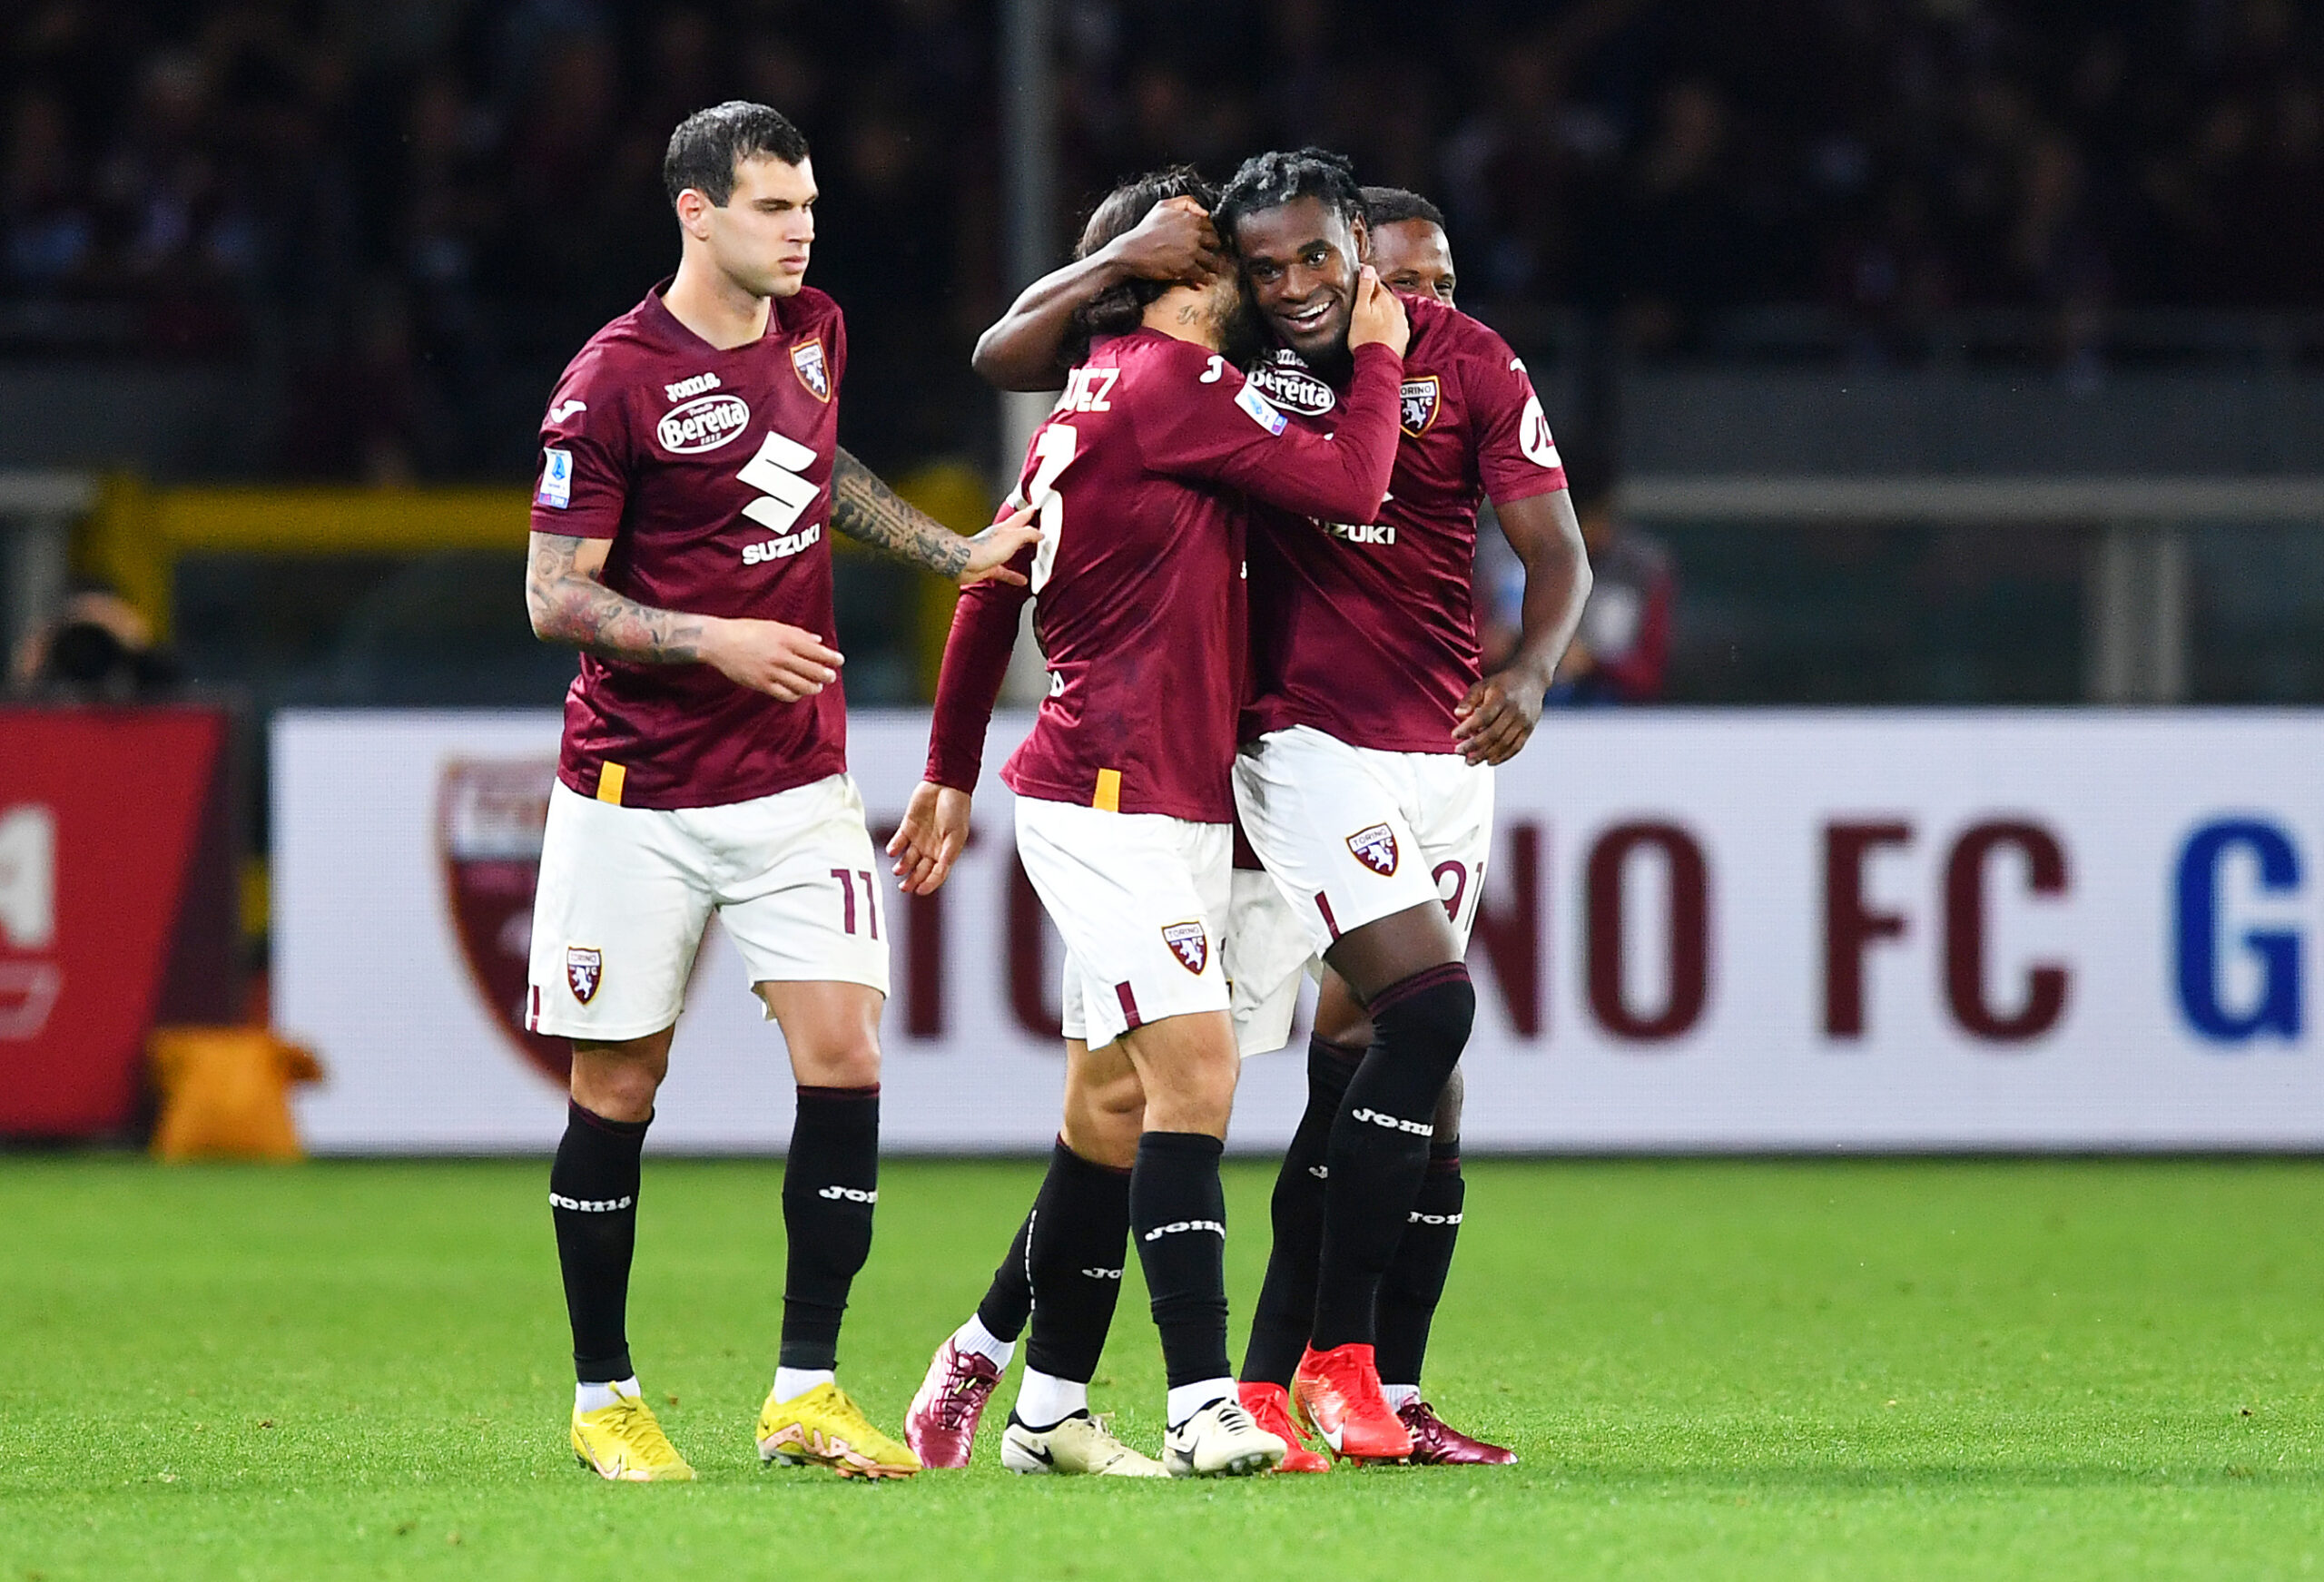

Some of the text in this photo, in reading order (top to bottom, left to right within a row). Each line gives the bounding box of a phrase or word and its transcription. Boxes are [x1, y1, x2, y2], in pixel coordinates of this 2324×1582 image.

[1058, 368, 1120, 411] UEZ
[1401, 386, 1432, 396] ORINO
[663, 403, 744, 447] Beretta
[743, 524, 821, 565] SUZUKI
[1308, 516, 1395, 545] ZUKI
[1354, 829, 1388, 847] TORINO
[832, 869, 878, 940] 11
[1432, 860, 1483, 931] 91
[1824, 818, 2073, 1043] FC
[2172, 817, 2304, 1043] G
[1353, 1108, 1434, 1136] Jom
[1145, 1220, 1226, 1241] Jom
[1082, 1268, 1126, 1279] Jo
